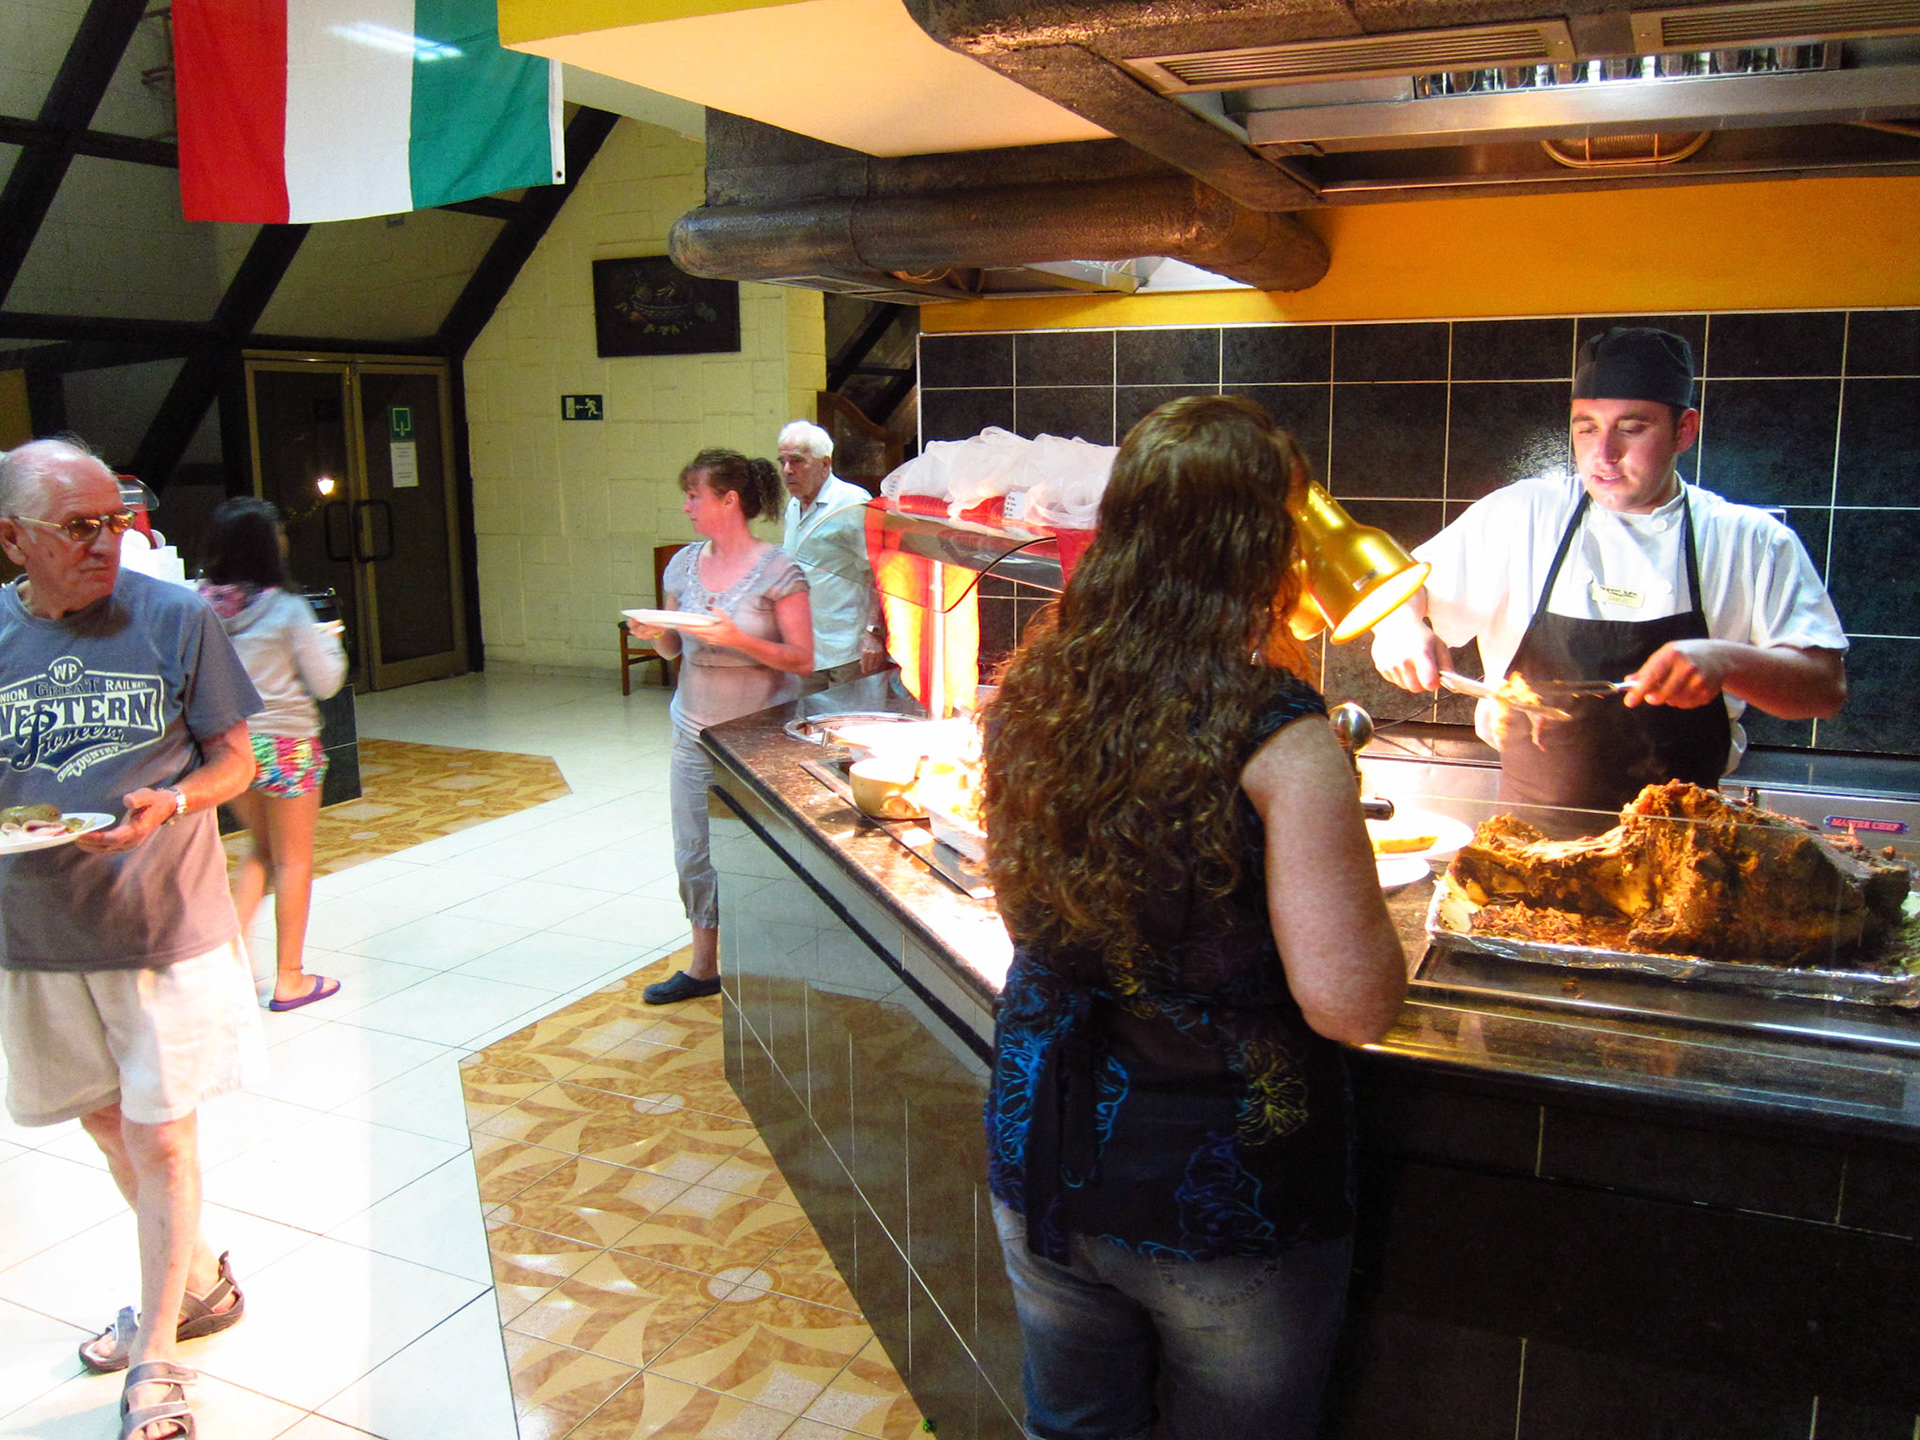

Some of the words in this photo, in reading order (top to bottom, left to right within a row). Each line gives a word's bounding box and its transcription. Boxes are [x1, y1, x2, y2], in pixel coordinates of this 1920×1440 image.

[53, 663, 78, 680] WP
[0, 687, 28, 701] NION
[35, 678, 100, 698] GREAT
[105, 679, 147, 691] RAILWAYS
